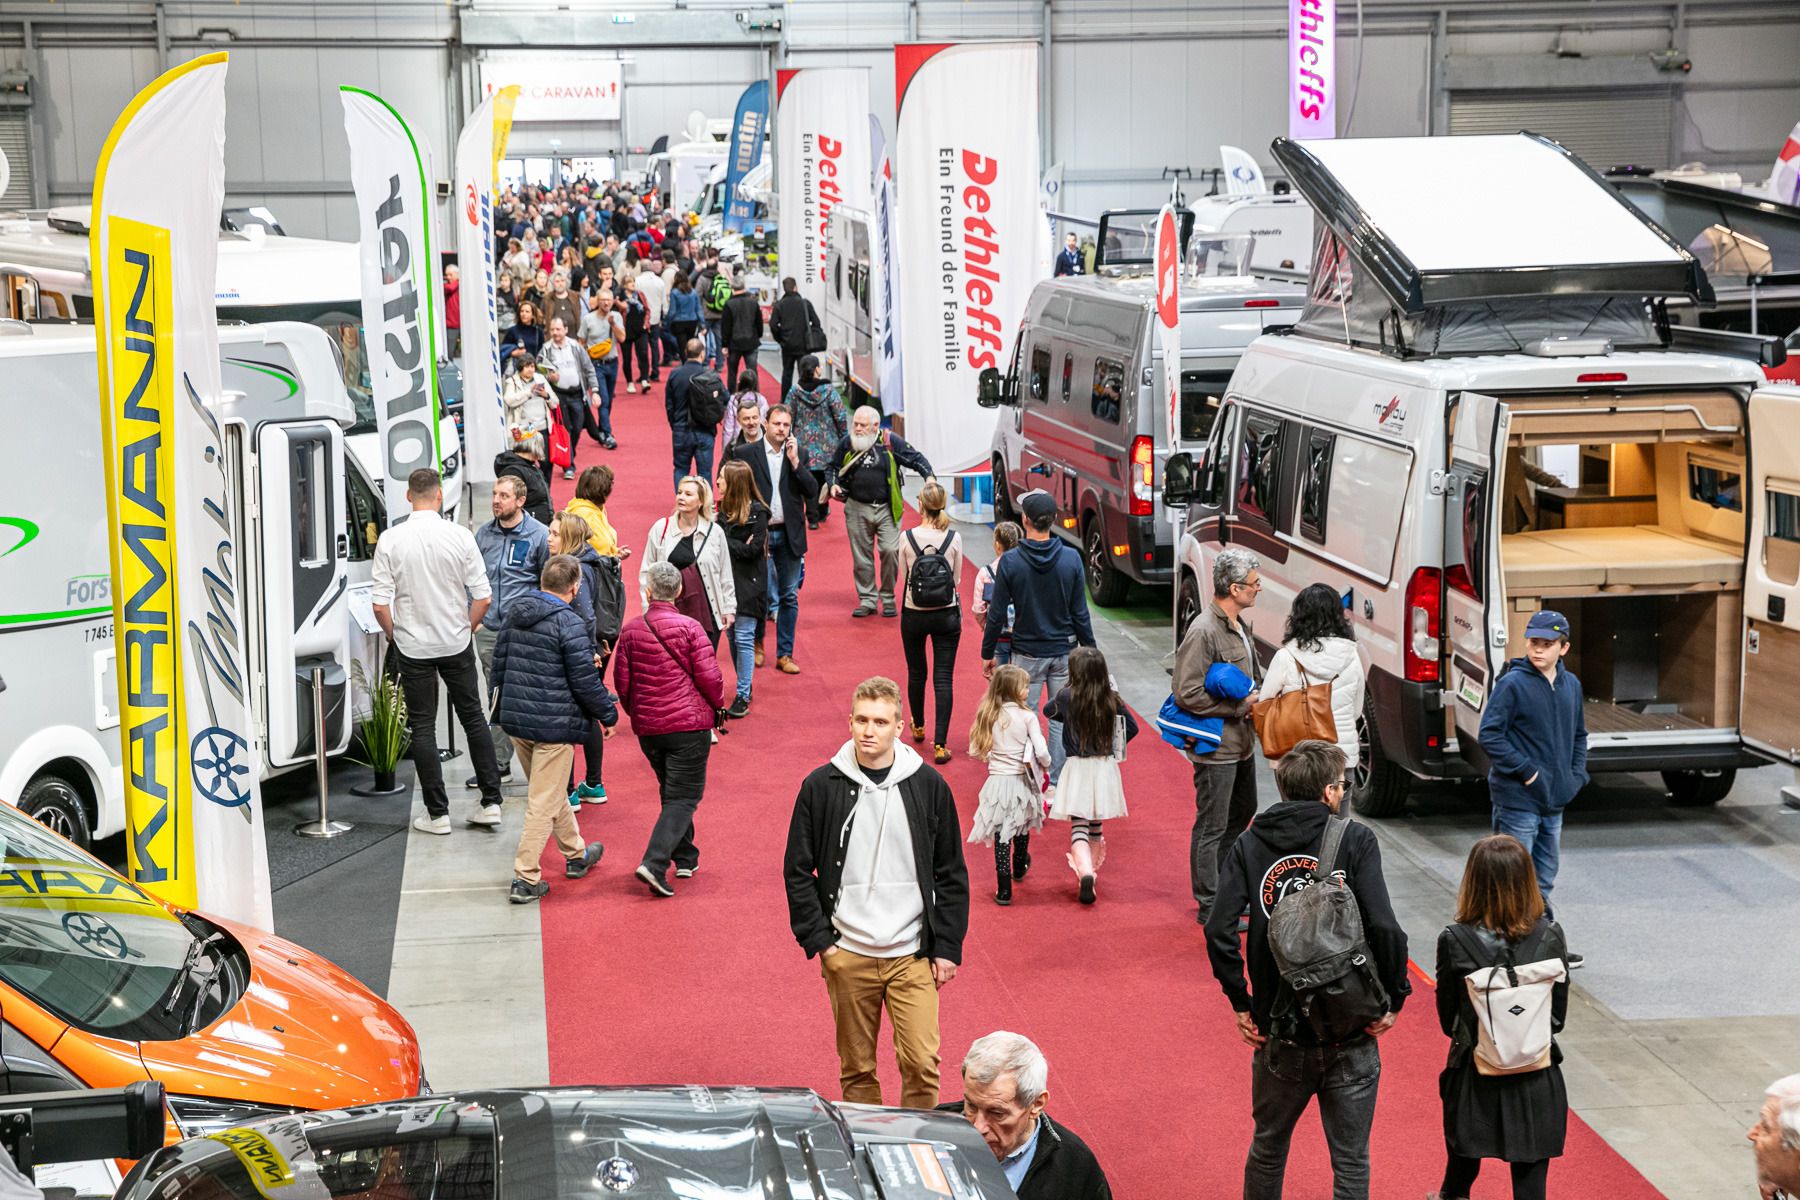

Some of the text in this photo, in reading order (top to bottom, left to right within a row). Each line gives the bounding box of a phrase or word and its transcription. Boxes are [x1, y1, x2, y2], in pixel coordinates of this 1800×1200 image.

[531, 86, 606, 99] CARAVAN
[736, 111, 758, 172] notin
[803, 133, 816, 284] Ein Freund der Familie
[939, 148, 961, 372] Ein Freund der Familie
[961, 149, 1002, 369] Dethleffs
[122, 248, 168, 883] KARMANN
[85, 629, 89, 643] T
[91, 625, 108, 642] 745
[1263, 858, 1319, 905] QUIKSILVER
